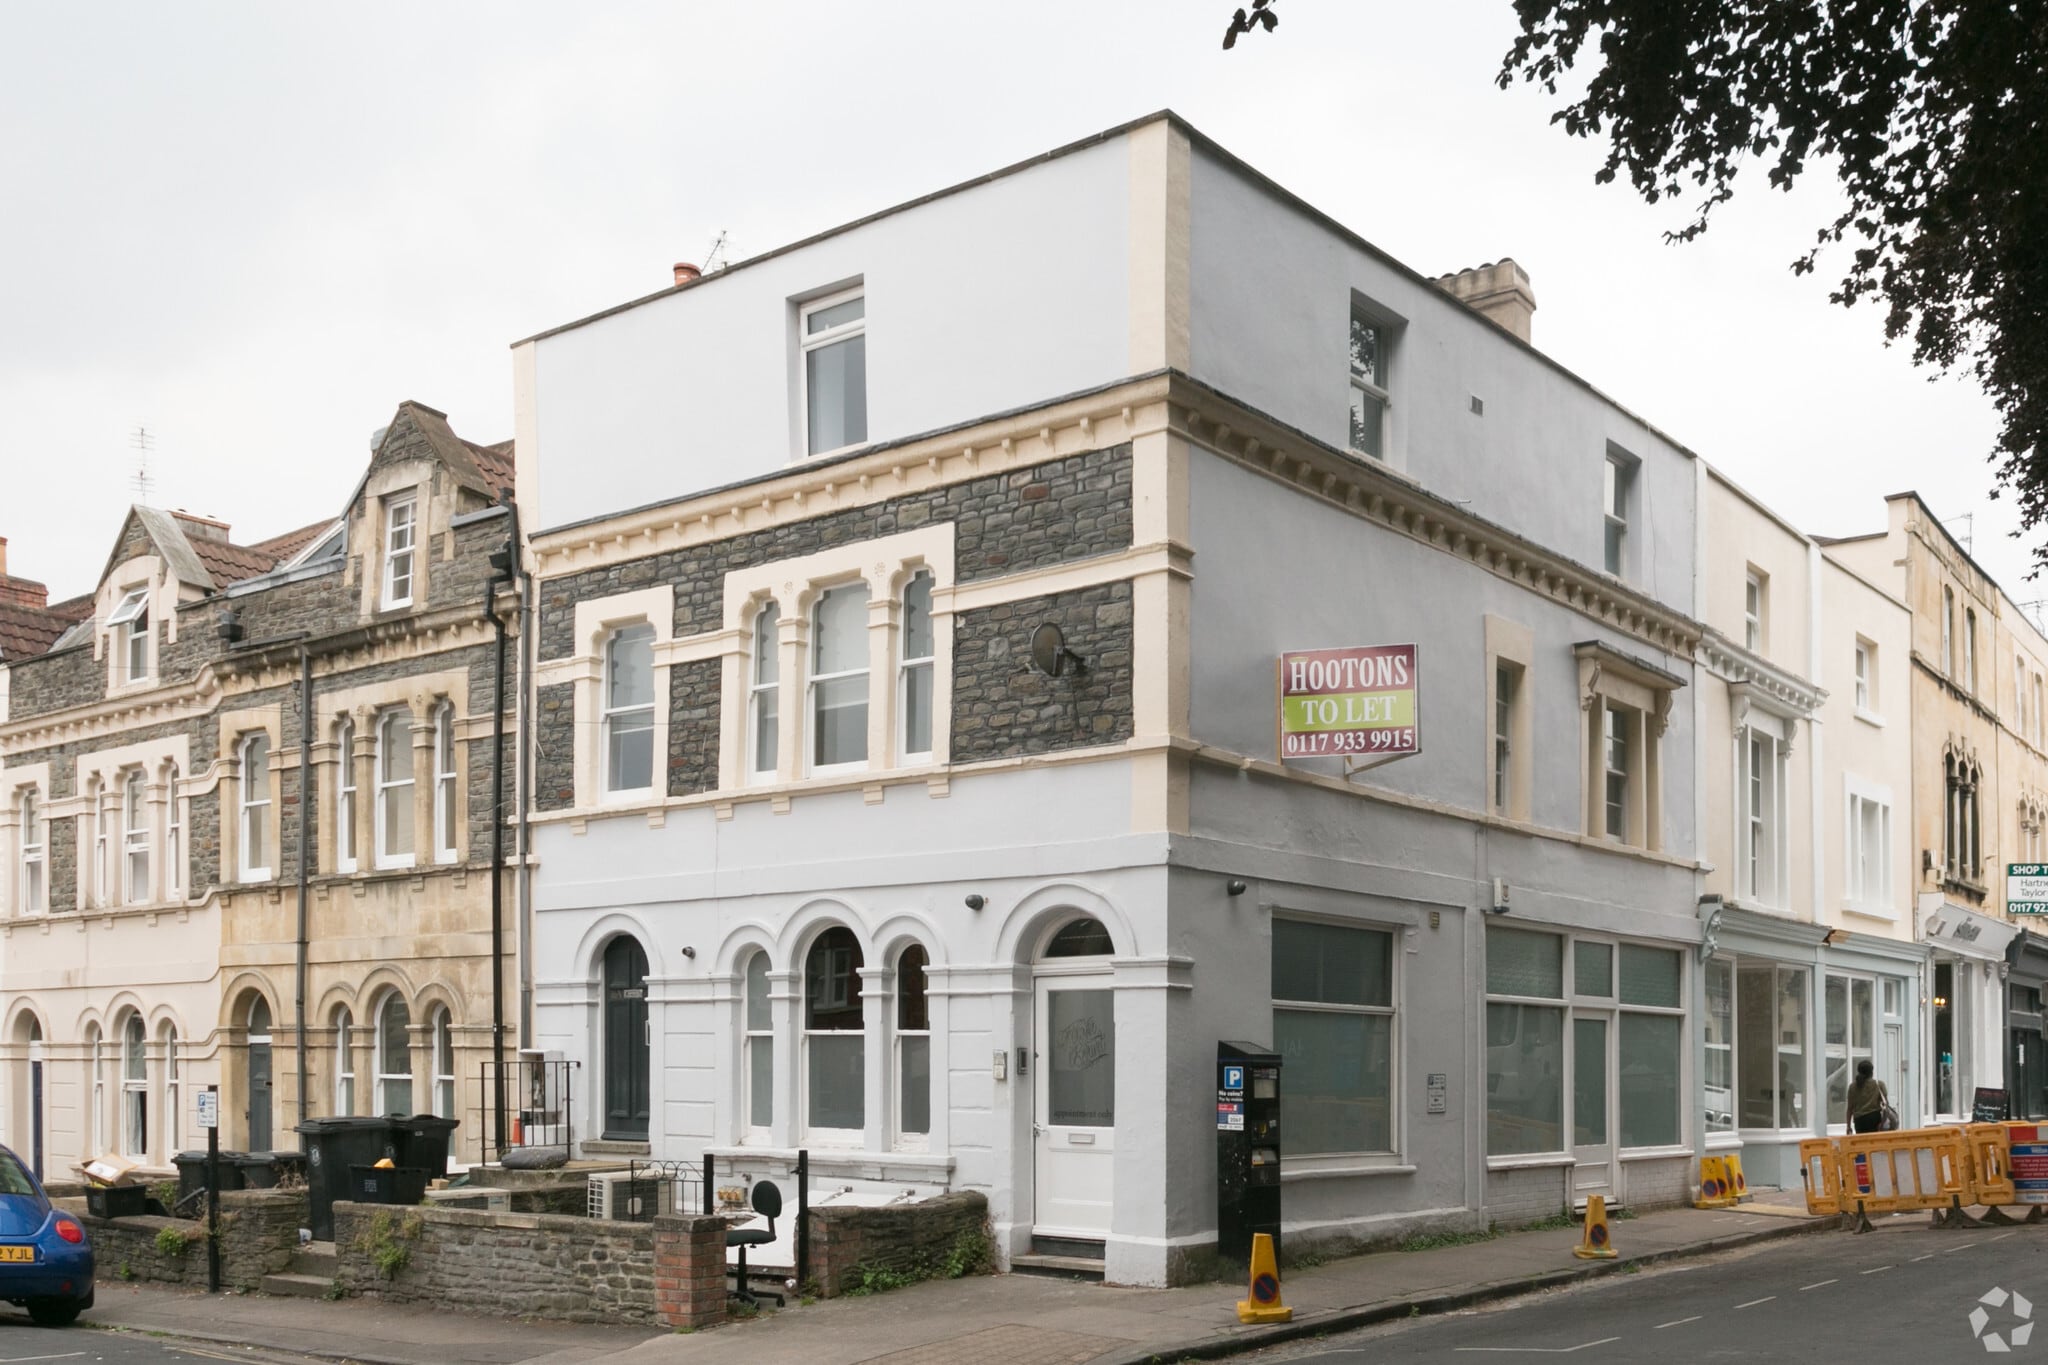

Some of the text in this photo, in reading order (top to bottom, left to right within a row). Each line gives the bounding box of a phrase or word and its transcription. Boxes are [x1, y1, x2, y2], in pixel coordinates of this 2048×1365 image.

[1289, 655, 1408, 692] HOOTONS
[1301, 695, 1397, 725] TO LET
[1287, 729, 1413, 753] 0117 933 9915
[2012, 865, 2040, 875] SHOP
[2020, 888, 2046, 898] Taylor
[2009, 902, 2032, 913] 0117
[1229, 1070, 1241, 1086] P
